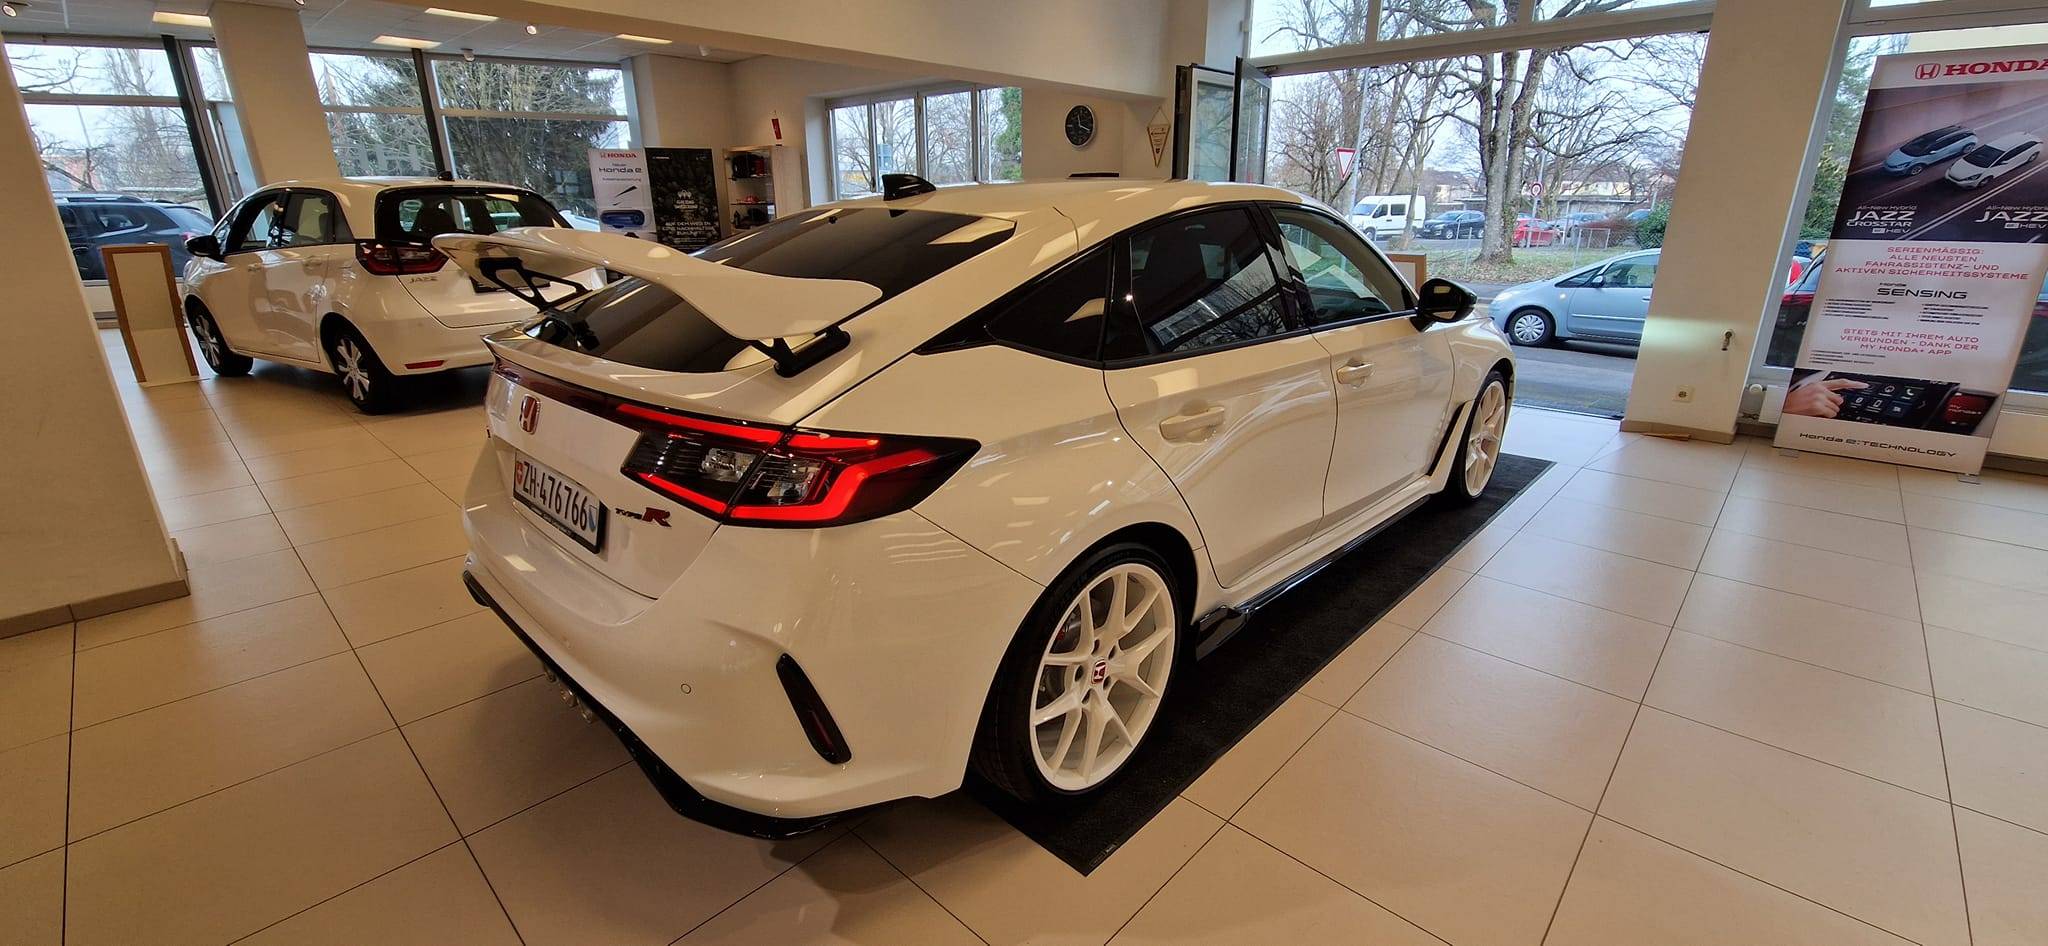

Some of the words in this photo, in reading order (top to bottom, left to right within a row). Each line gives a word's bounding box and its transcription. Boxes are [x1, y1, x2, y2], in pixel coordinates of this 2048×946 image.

[1848, 211, 1915, 222] JAZZ
[1975, 211, 2048, 223] JAZZ
[1865, 261, 1969, 270] FAHRASSISTENZ-
[1835, 267, 1886, 275] AKTIVEN
[1888, 268, 2029, 280] SICHERHEITSSYSTEME
[1877, 288, 1968, 299] SENSING
[1843, 328, 1878, 336] STETS
[1905, 332, 1944, 340] IHREM
[1840, 335, 1908, 345] VERBUNDEN
[1919, 341, 1951, 349] DANK
[1955, 343, 1979, 351] DER
[1799, 432, 1843, 443] Honda
